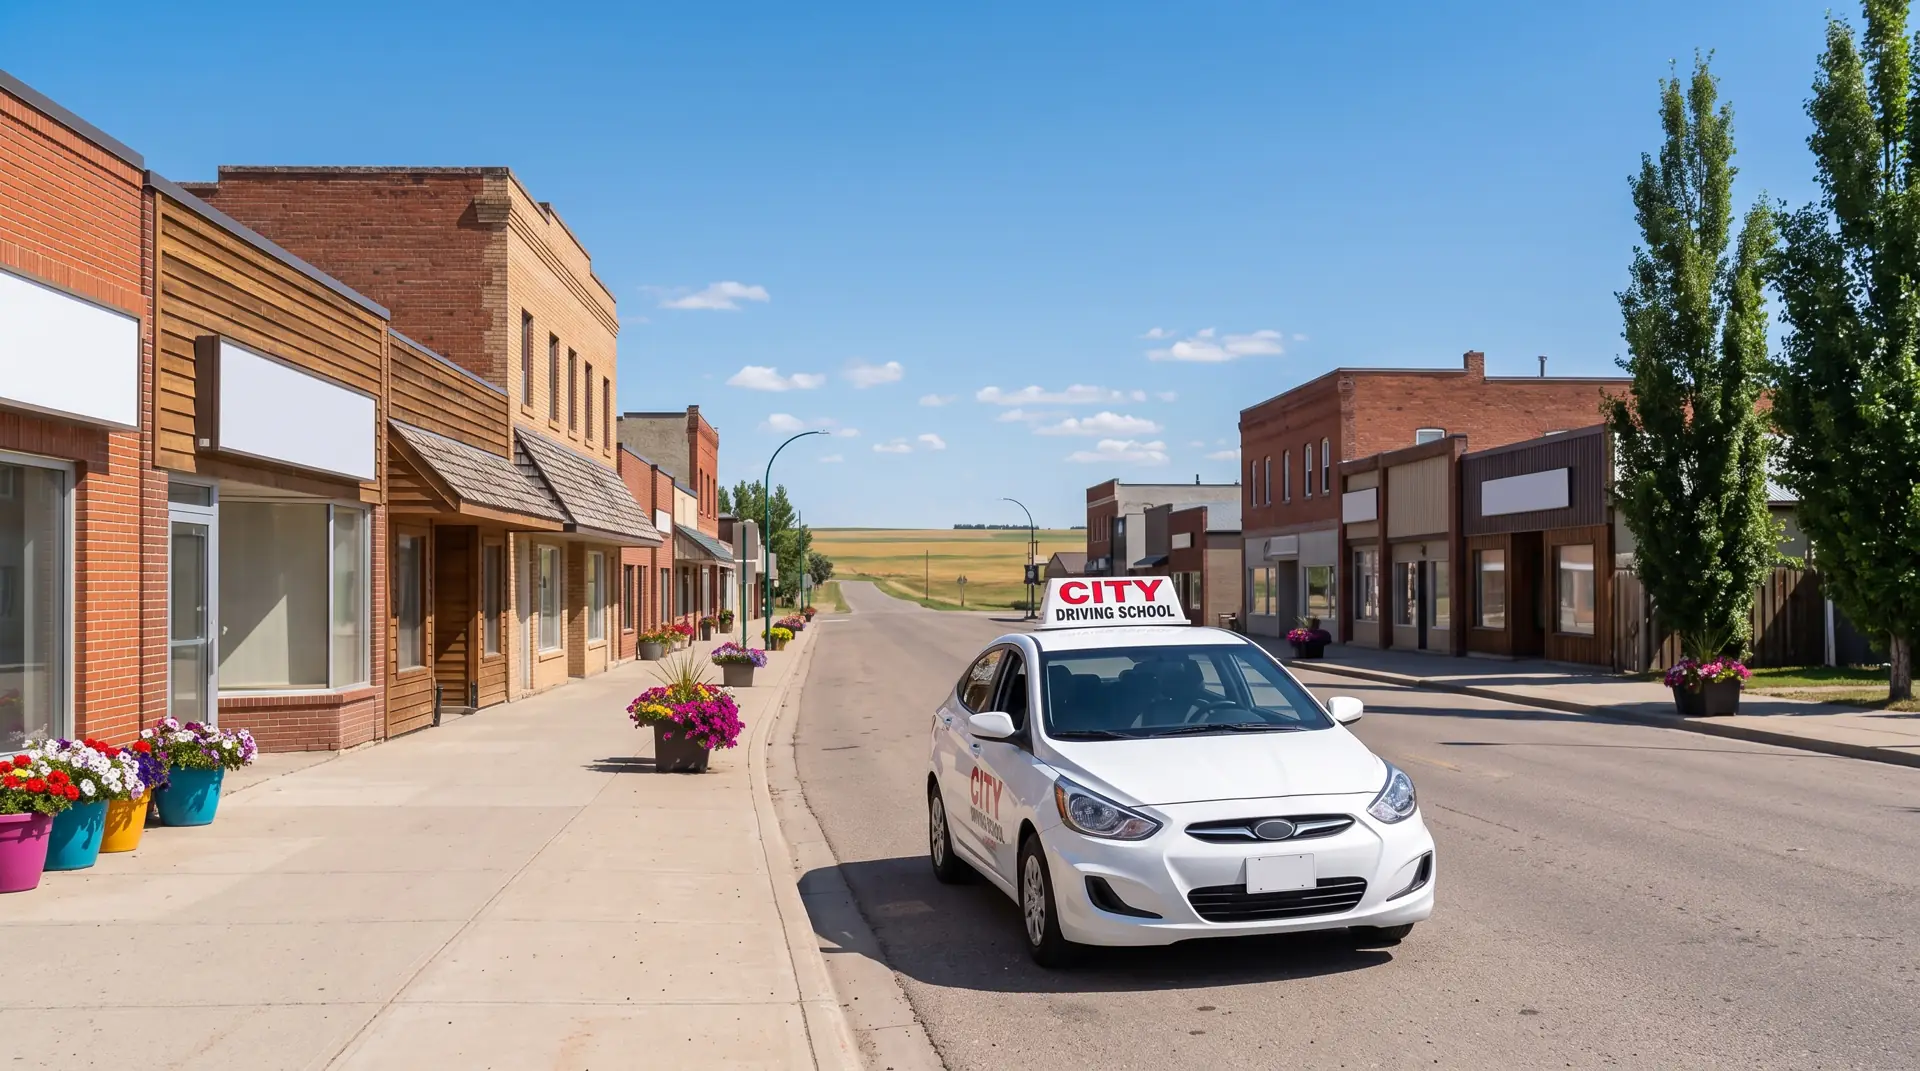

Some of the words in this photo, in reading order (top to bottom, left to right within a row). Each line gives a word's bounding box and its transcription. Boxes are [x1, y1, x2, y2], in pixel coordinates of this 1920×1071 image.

[1059, 579, 1163, 604] CITY
[1056, 606, 1114, 621] DRIVING
[1118, 605, 1175, 618] SCHOOL
[971, 766, 1003, 820] CITY
